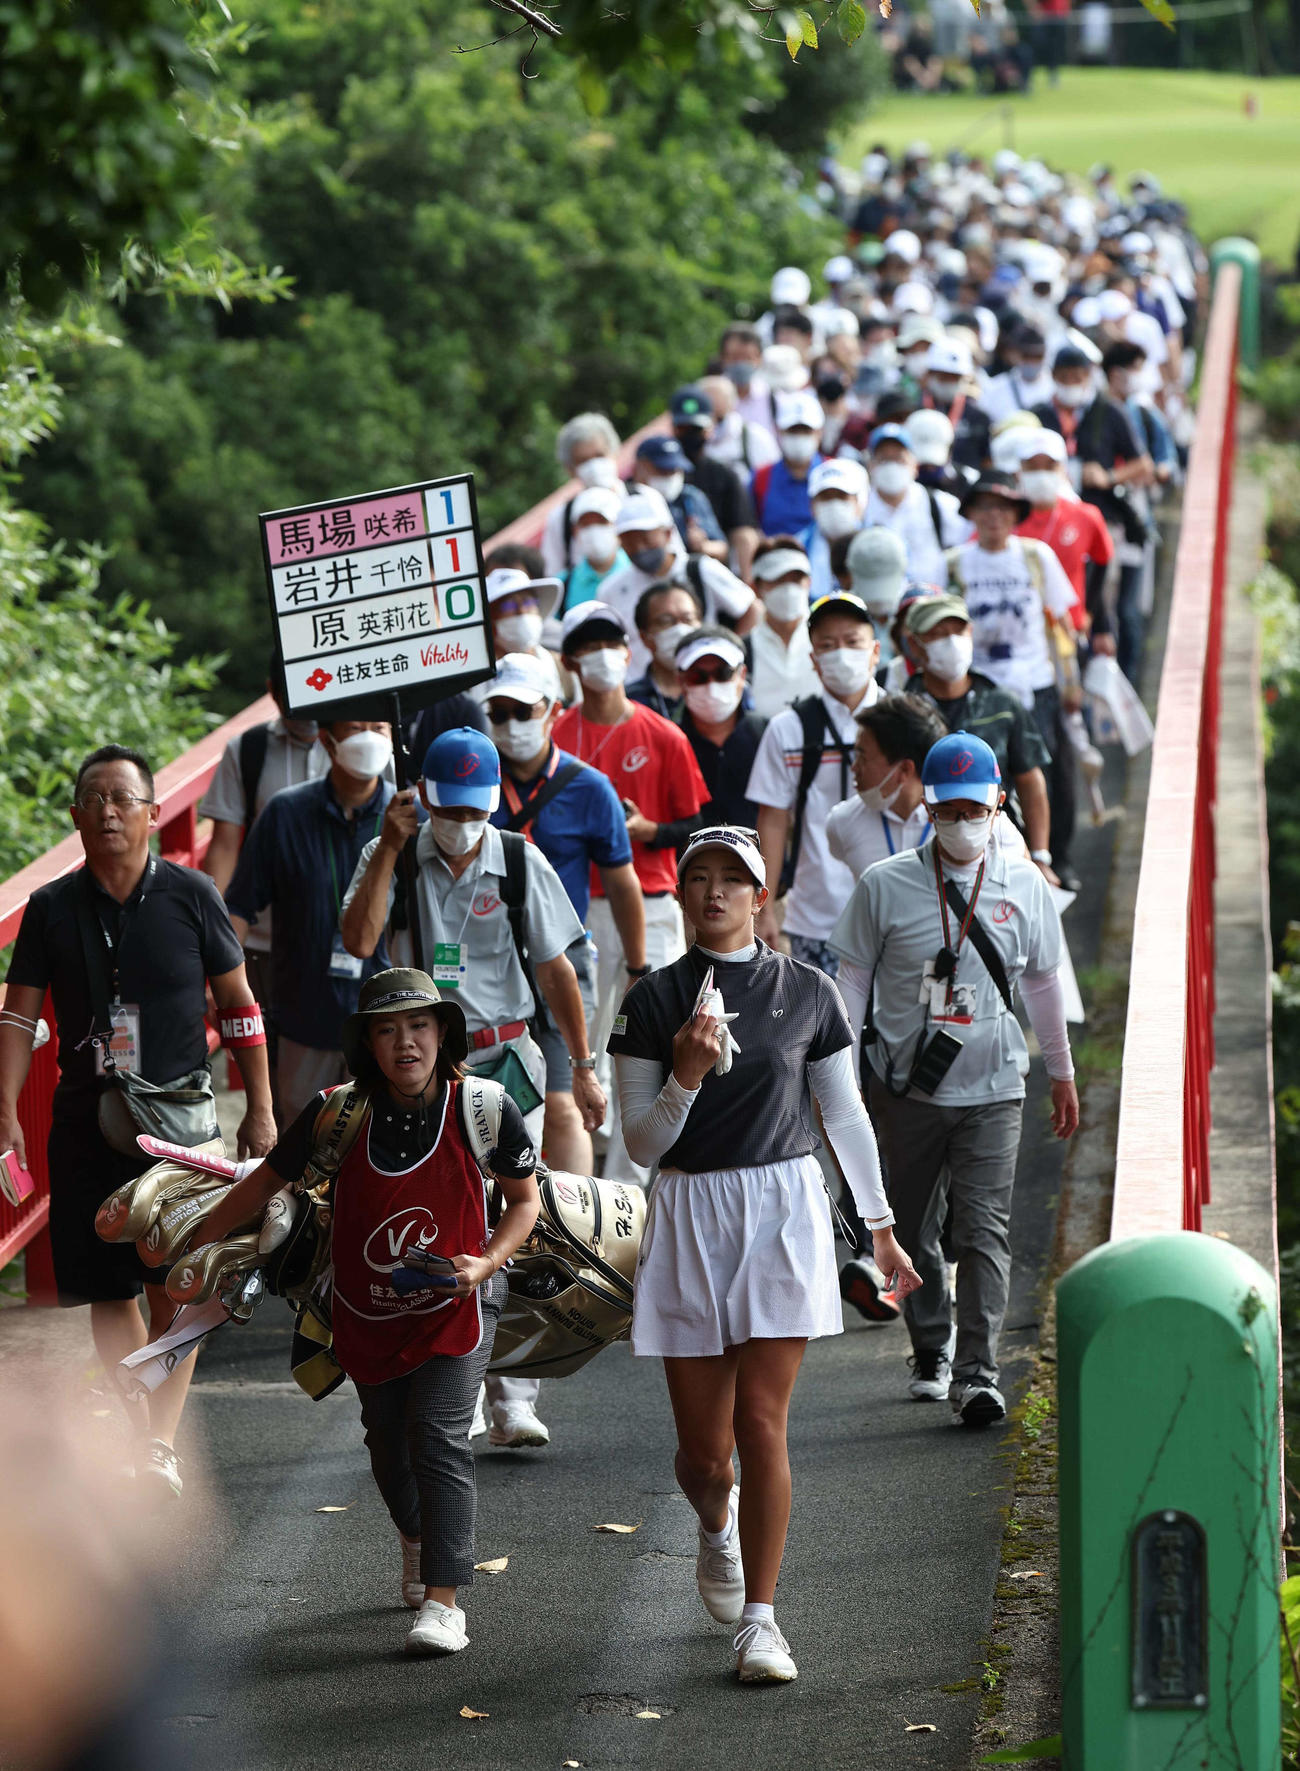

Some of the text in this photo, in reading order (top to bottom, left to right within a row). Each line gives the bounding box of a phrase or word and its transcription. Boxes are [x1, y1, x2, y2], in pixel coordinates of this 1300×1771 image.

[280, 490, 454, 557] 馬場 咲希 1
[284, 537, 460, 605] 岩井 千怜 1
[311, 584, 476, 648] 原 英莉花 0
[336, 642, 469, 684] 住友生命 Vitality
[472, 1089, 493, 1144] FRANCK
[162, 1199, 198, 1225] MASTER
[165, 1204, 201, 1231] EDITION
